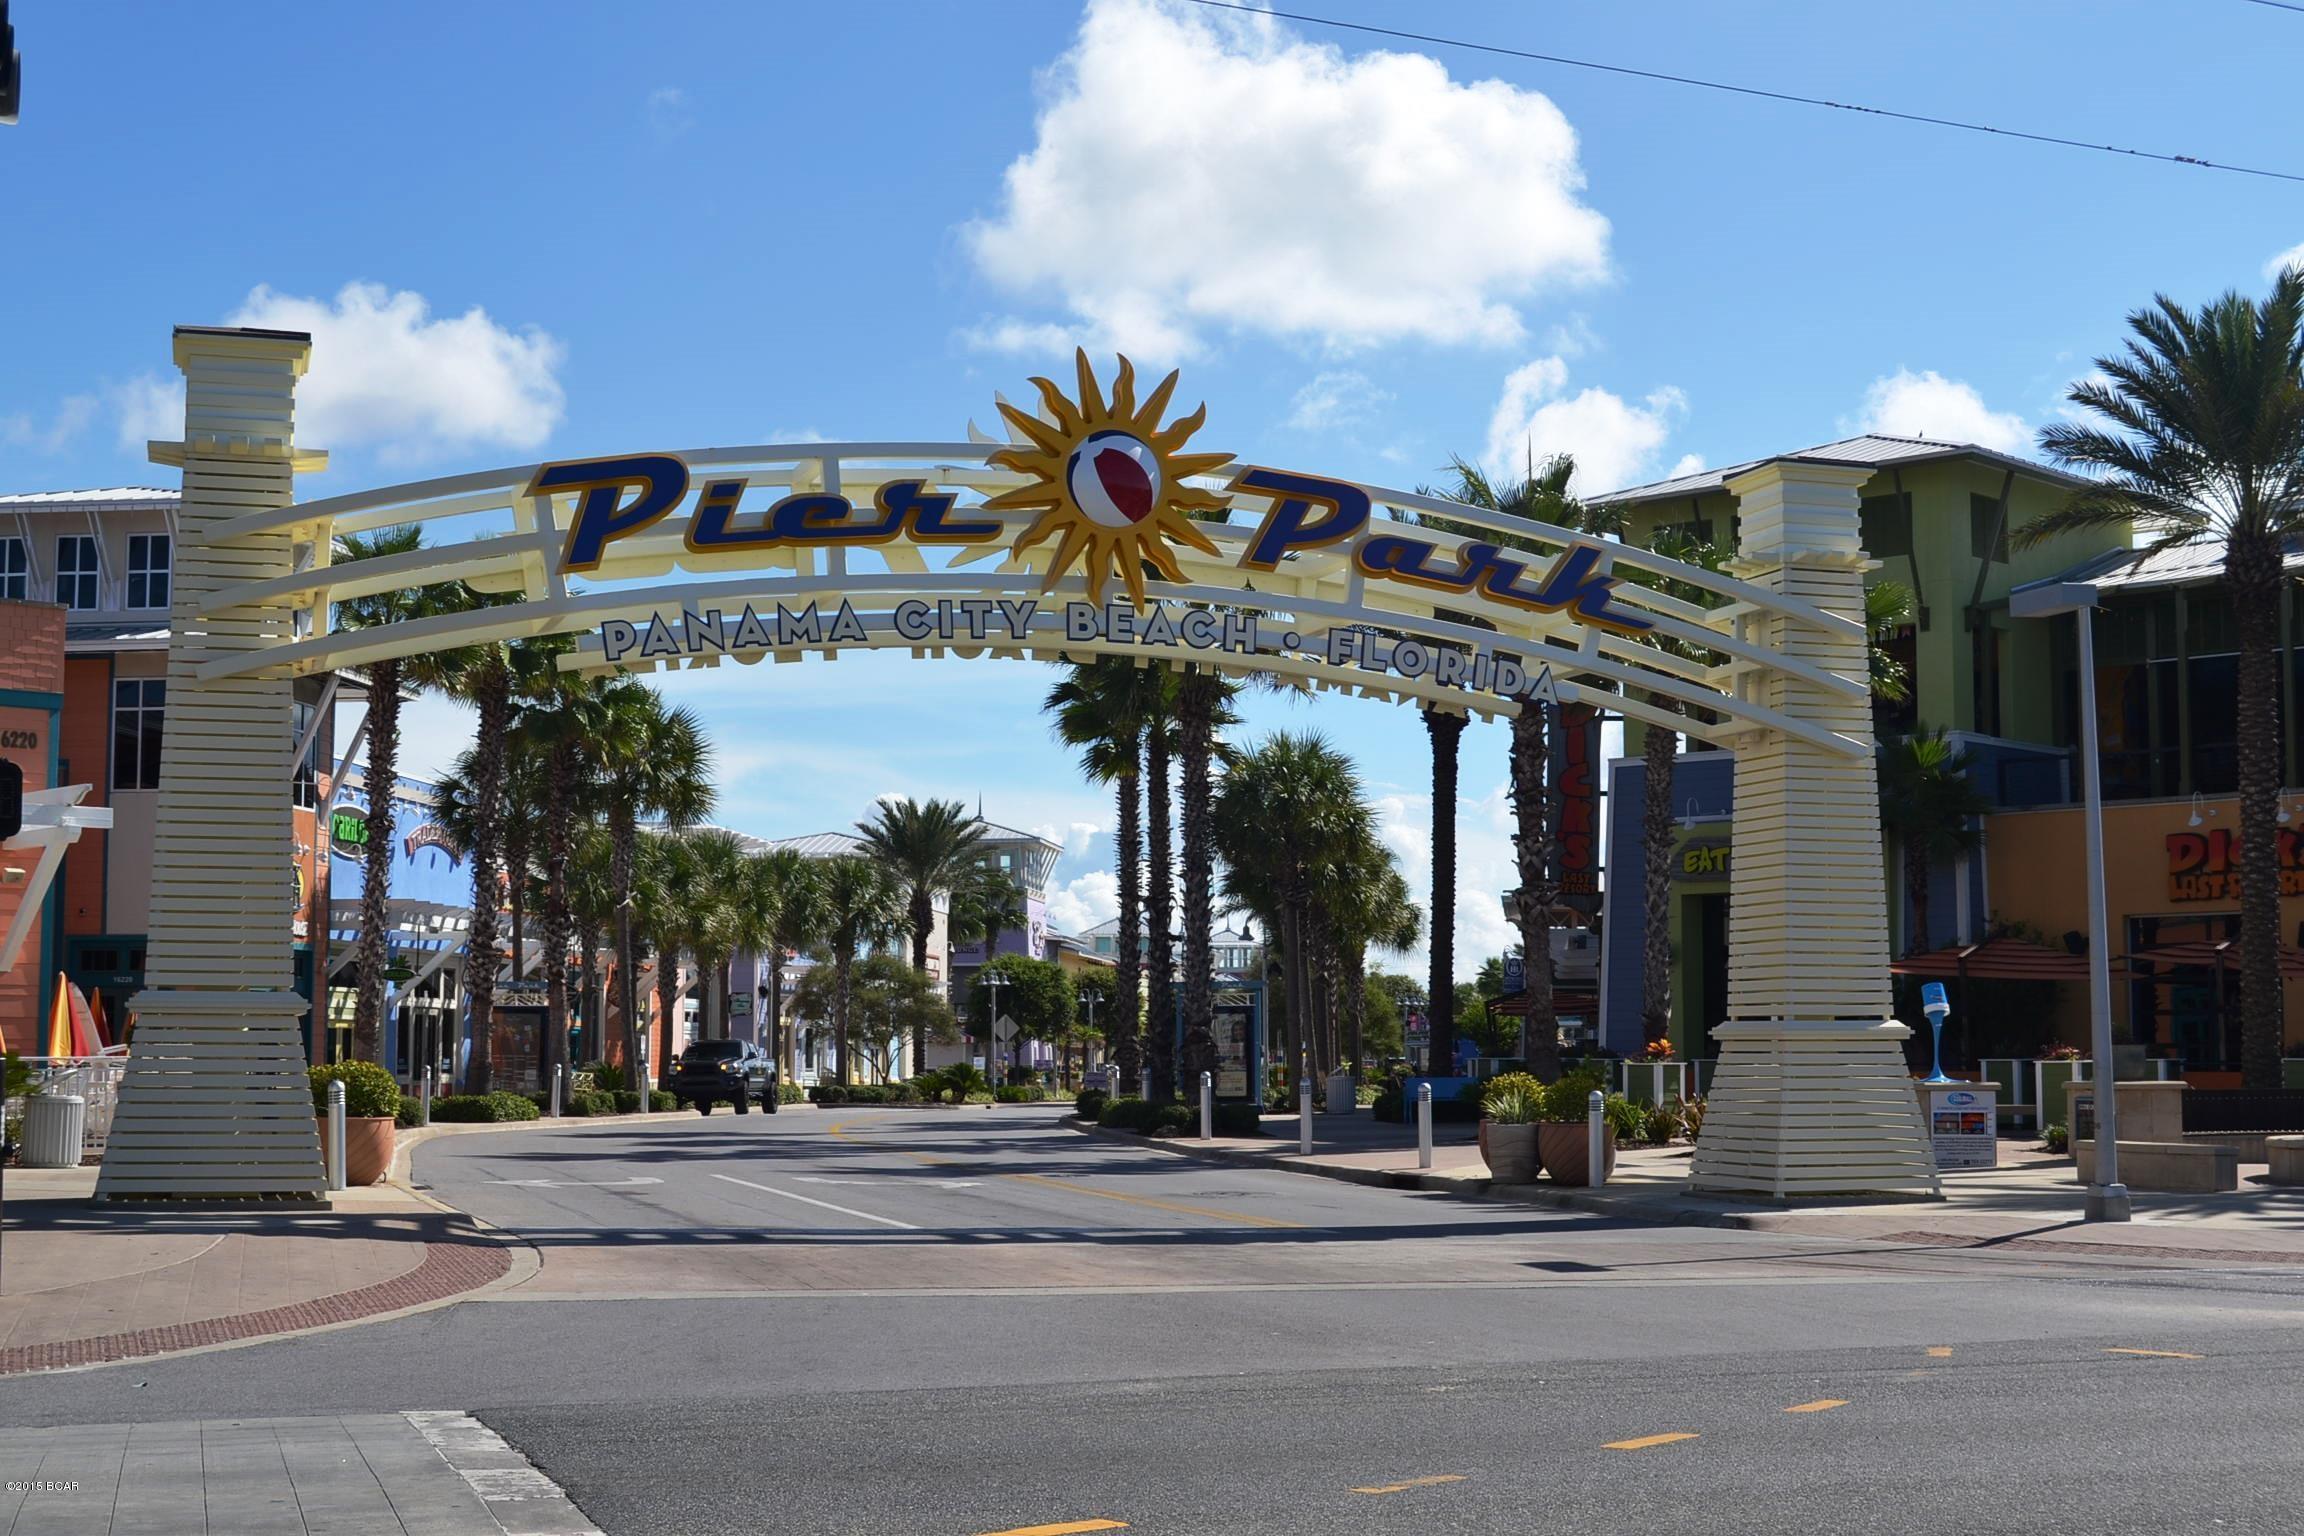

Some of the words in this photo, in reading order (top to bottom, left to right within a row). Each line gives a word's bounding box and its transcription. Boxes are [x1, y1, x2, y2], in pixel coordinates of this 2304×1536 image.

[523, 452, 1004, 574] Pier
[1227, 464, 1658, 637] Park
[601, 597, 868, 662] PANAMA
[893, 599, 1038, 640] CITY
[1066, 602, 1258, 655] BEACH
[1327, 627, 1558, 706] FLORIDA
[1683, 845, 1731, 873] EAT
[2168, 872, 2225, 903] LAST
